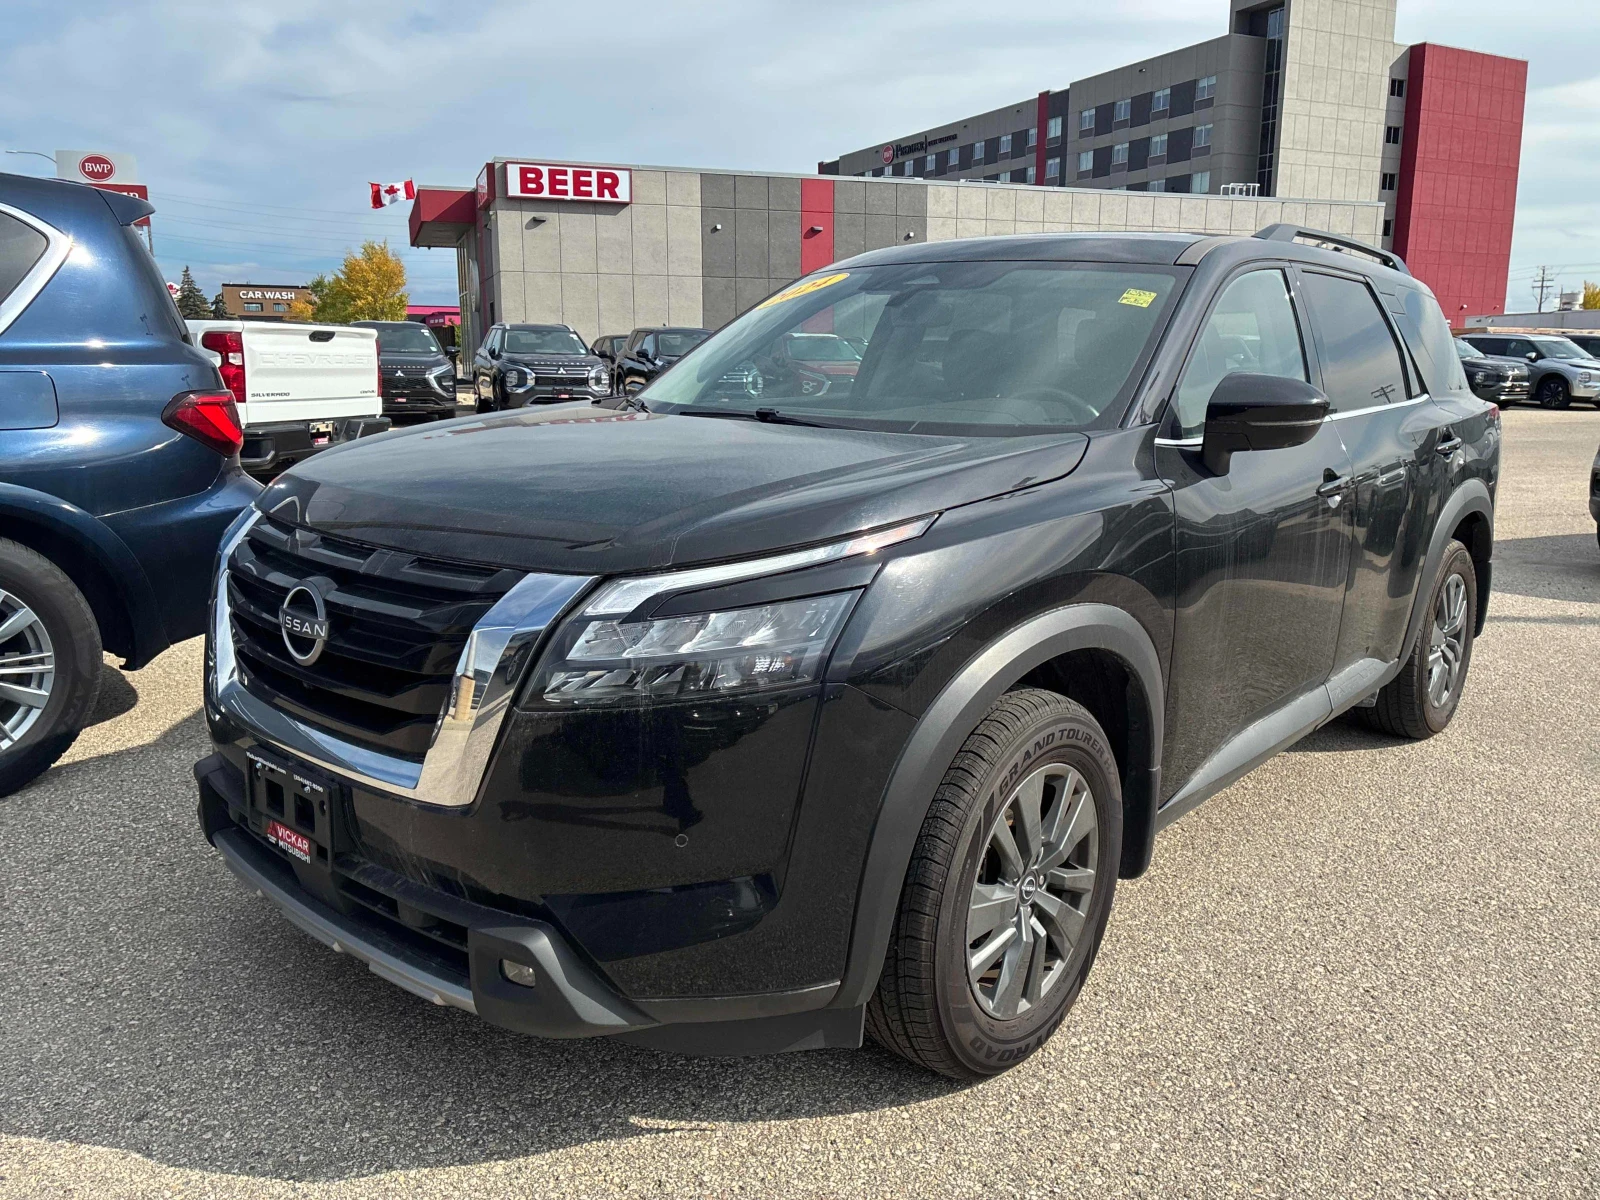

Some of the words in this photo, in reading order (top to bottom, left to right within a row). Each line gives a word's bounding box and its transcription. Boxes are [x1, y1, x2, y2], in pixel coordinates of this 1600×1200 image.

[85, 162, 111, 173] BWP
[519, 166, 620, 199] BEER
[240, 291, 262, 299] CAR
[264, 291, 295, 300] WASH
[259, 353, 373, 367] CHEVROLET
[998, 732, 1056, 797] GRAND
[1058, 728, 1106, 759] TOURER
[277, 825, 310, 853] VICKAR
[278, 839, 311, 864] MITSUBISHI
